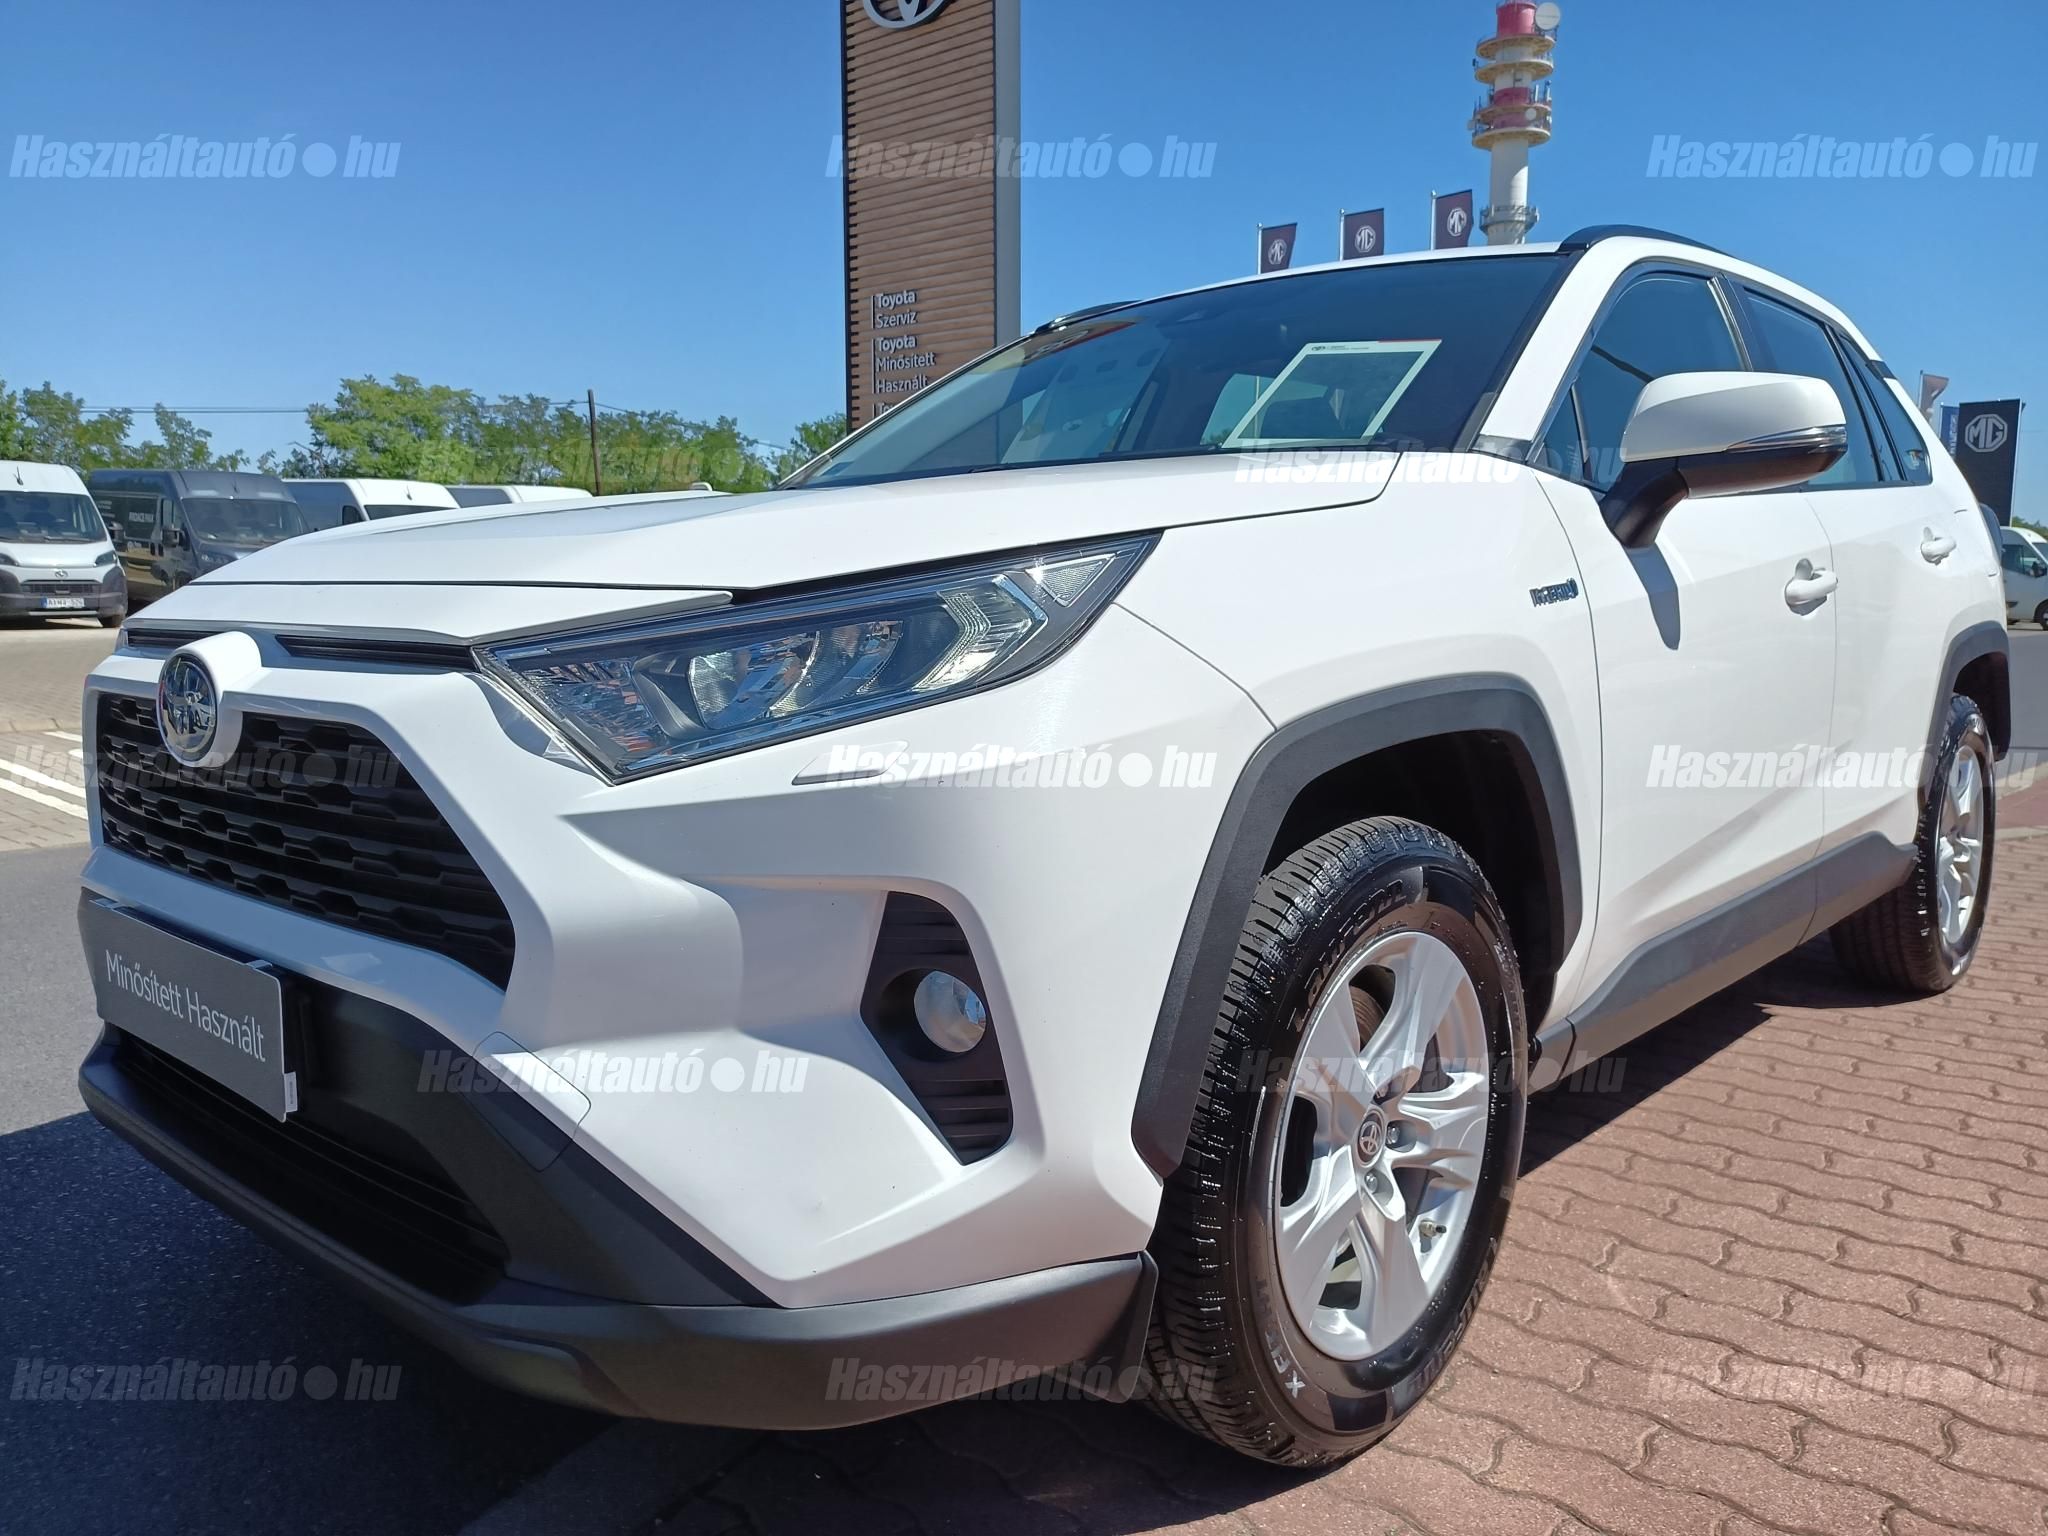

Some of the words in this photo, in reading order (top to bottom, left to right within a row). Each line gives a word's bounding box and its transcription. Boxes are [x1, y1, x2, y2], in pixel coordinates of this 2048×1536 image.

[876, 289, 917, 309] Toyota
[876, 310, 917, 329] Szerviz
[876, 335, 917, 353] Toyota
[876, 373, 928, 394] Használt
[1967, 418, 2004, 449] MG
[106, 950, 183, 1018] Minősített
[186, 987, 266, 1062] Használt
